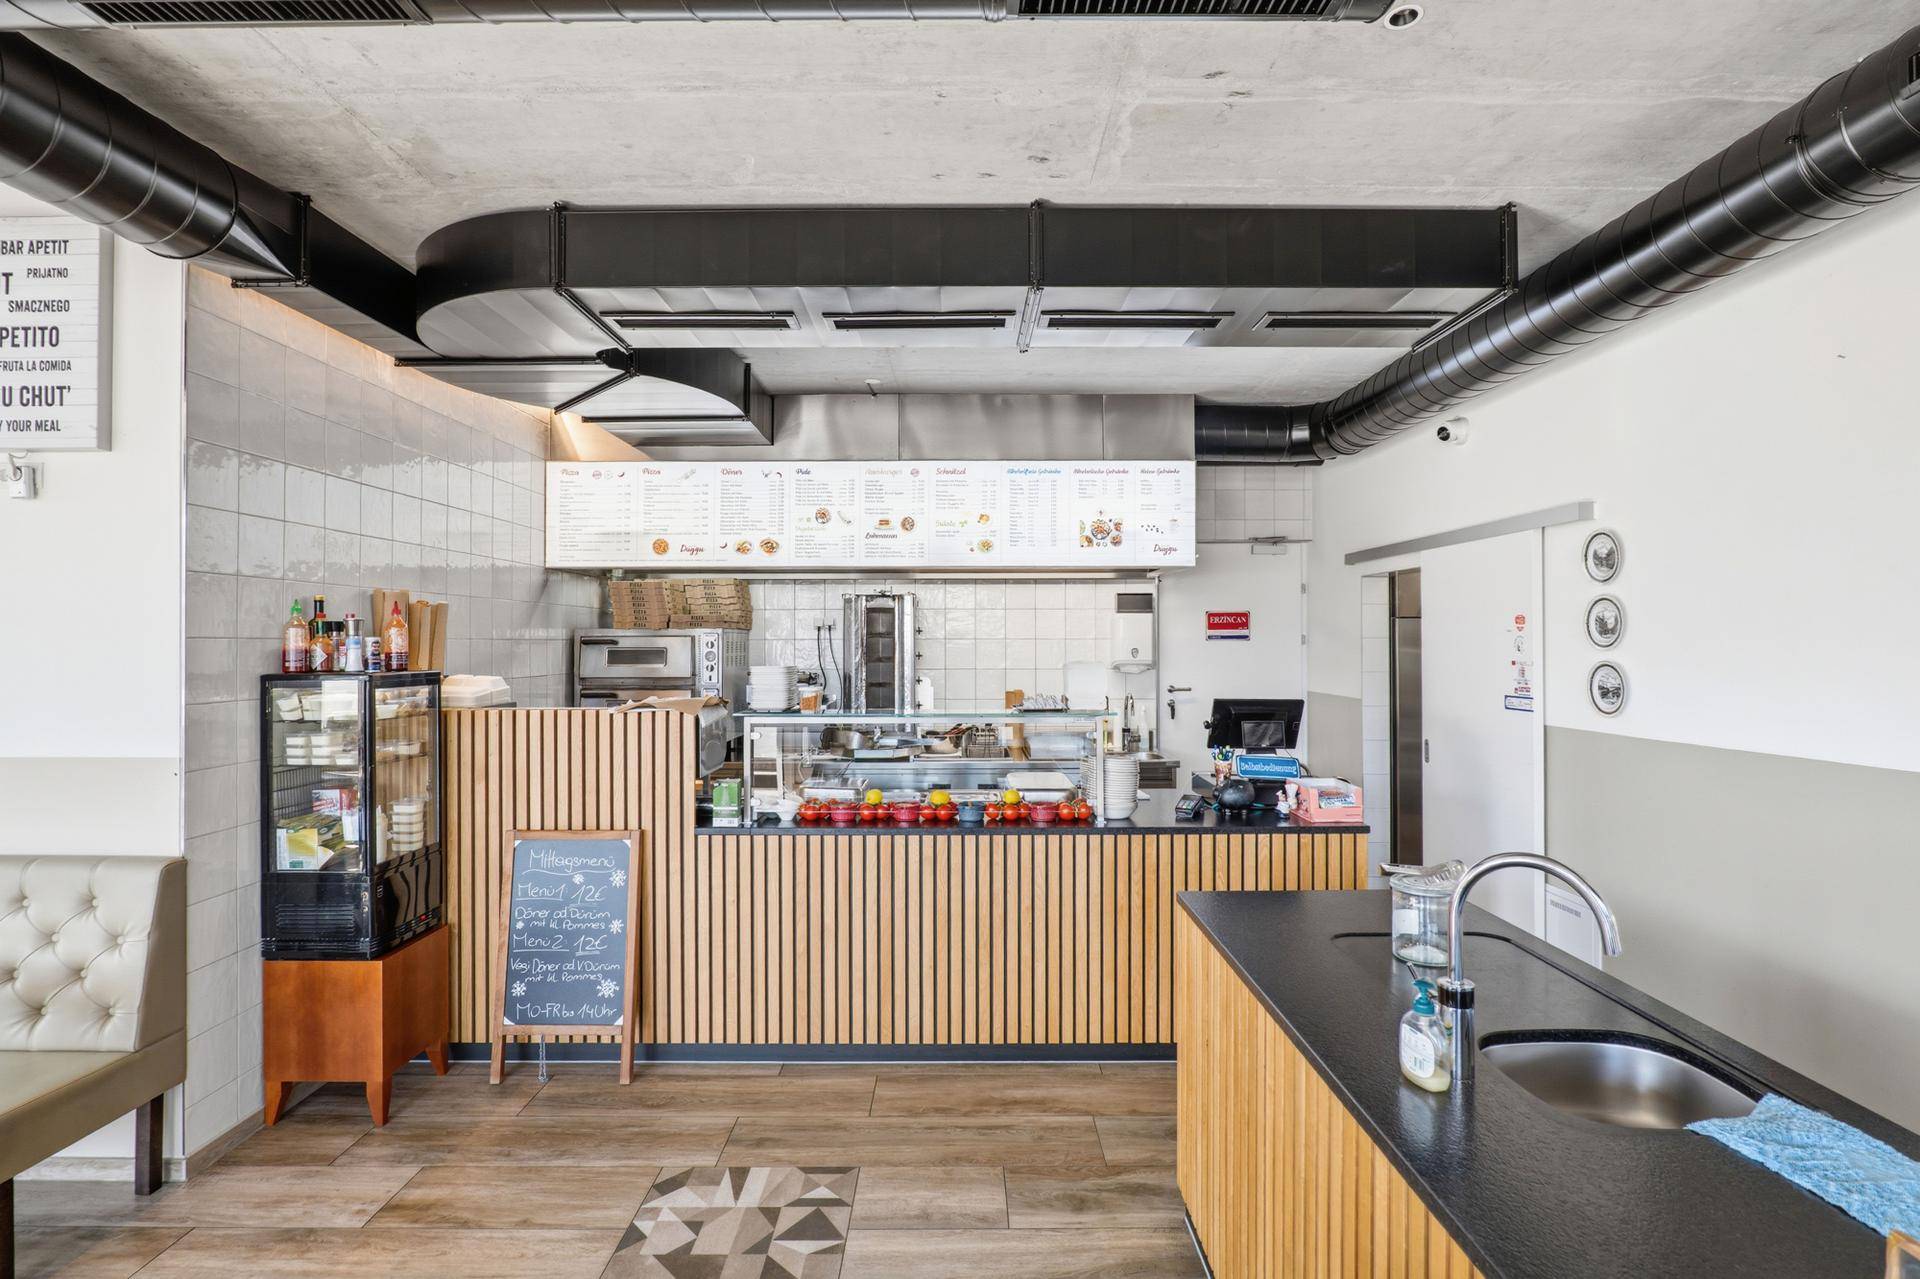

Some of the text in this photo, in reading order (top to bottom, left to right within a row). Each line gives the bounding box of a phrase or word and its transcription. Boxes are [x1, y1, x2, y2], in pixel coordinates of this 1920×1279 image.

[27, 239, 70, 255] APETIT
[26, 267, 69, 279] PRIJATNO
[8, 299, 71, 313] SMACZNEGO
[0, 325, 60, 348] PETITO
[26, 360, 37, 371] LA
[39, 360, 72, 372] COMIDA
[6, 419, 32, 432] YOUR
[35, 419, 61, 432] MEAL
[529, 848, 615, 873] Mittagsmenü
[570, 884, 608, 905] 12€
[515, 906, 550, 920] Döner
[569, 908, 611, 920] Dürüm
[529, 919, 546, 928] mit
[562, 919, 606, 931] Pommes
[573, 934, 608, 953] 12€
[532, 958, 560, 975] Döner
[524, 973, 545, 983] mit
[561, 971, 603, 982] Pommes
